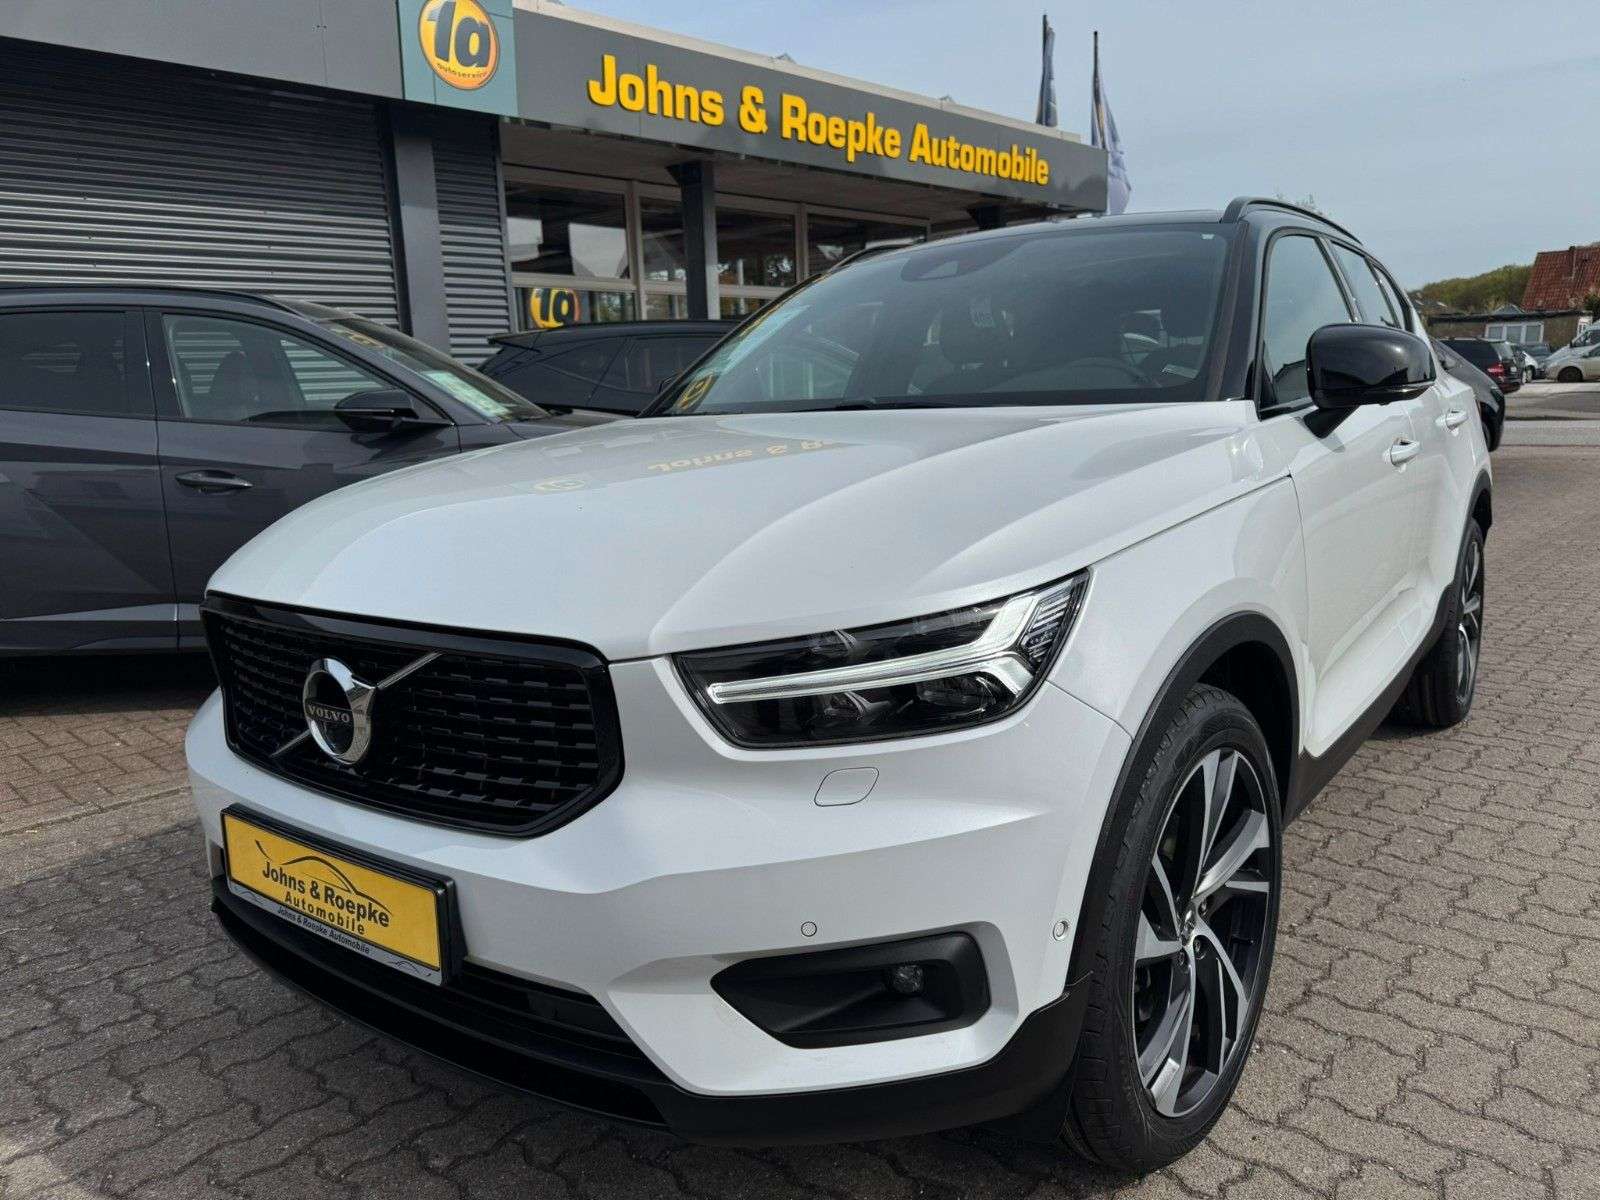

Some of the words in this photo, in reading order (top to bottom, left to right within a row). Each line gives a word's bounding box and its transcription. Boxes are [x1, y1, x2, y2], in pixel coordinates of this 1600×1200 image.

[427, 0, 490, 68] 1a
[588, 54, 725, 126] Johns
[739, 85, 769, 135] &
[781, 94, 901, 163] Roepke
[908, 123, 1050, 186] Automobile
[308, 704, 350, 723] VOLVO
[262, 861, 306, 894] Johns
[310, 880, 321, 901] &
[324, 885, 390, 928] Roepke
[284, 891, 365, 935] Automobile
[278, 906, 296, 920] Johns
[296, 916, 303, 924] &
[303, 917, 328, 935] Roepke
[329, 928, 370, 954] Automobile
